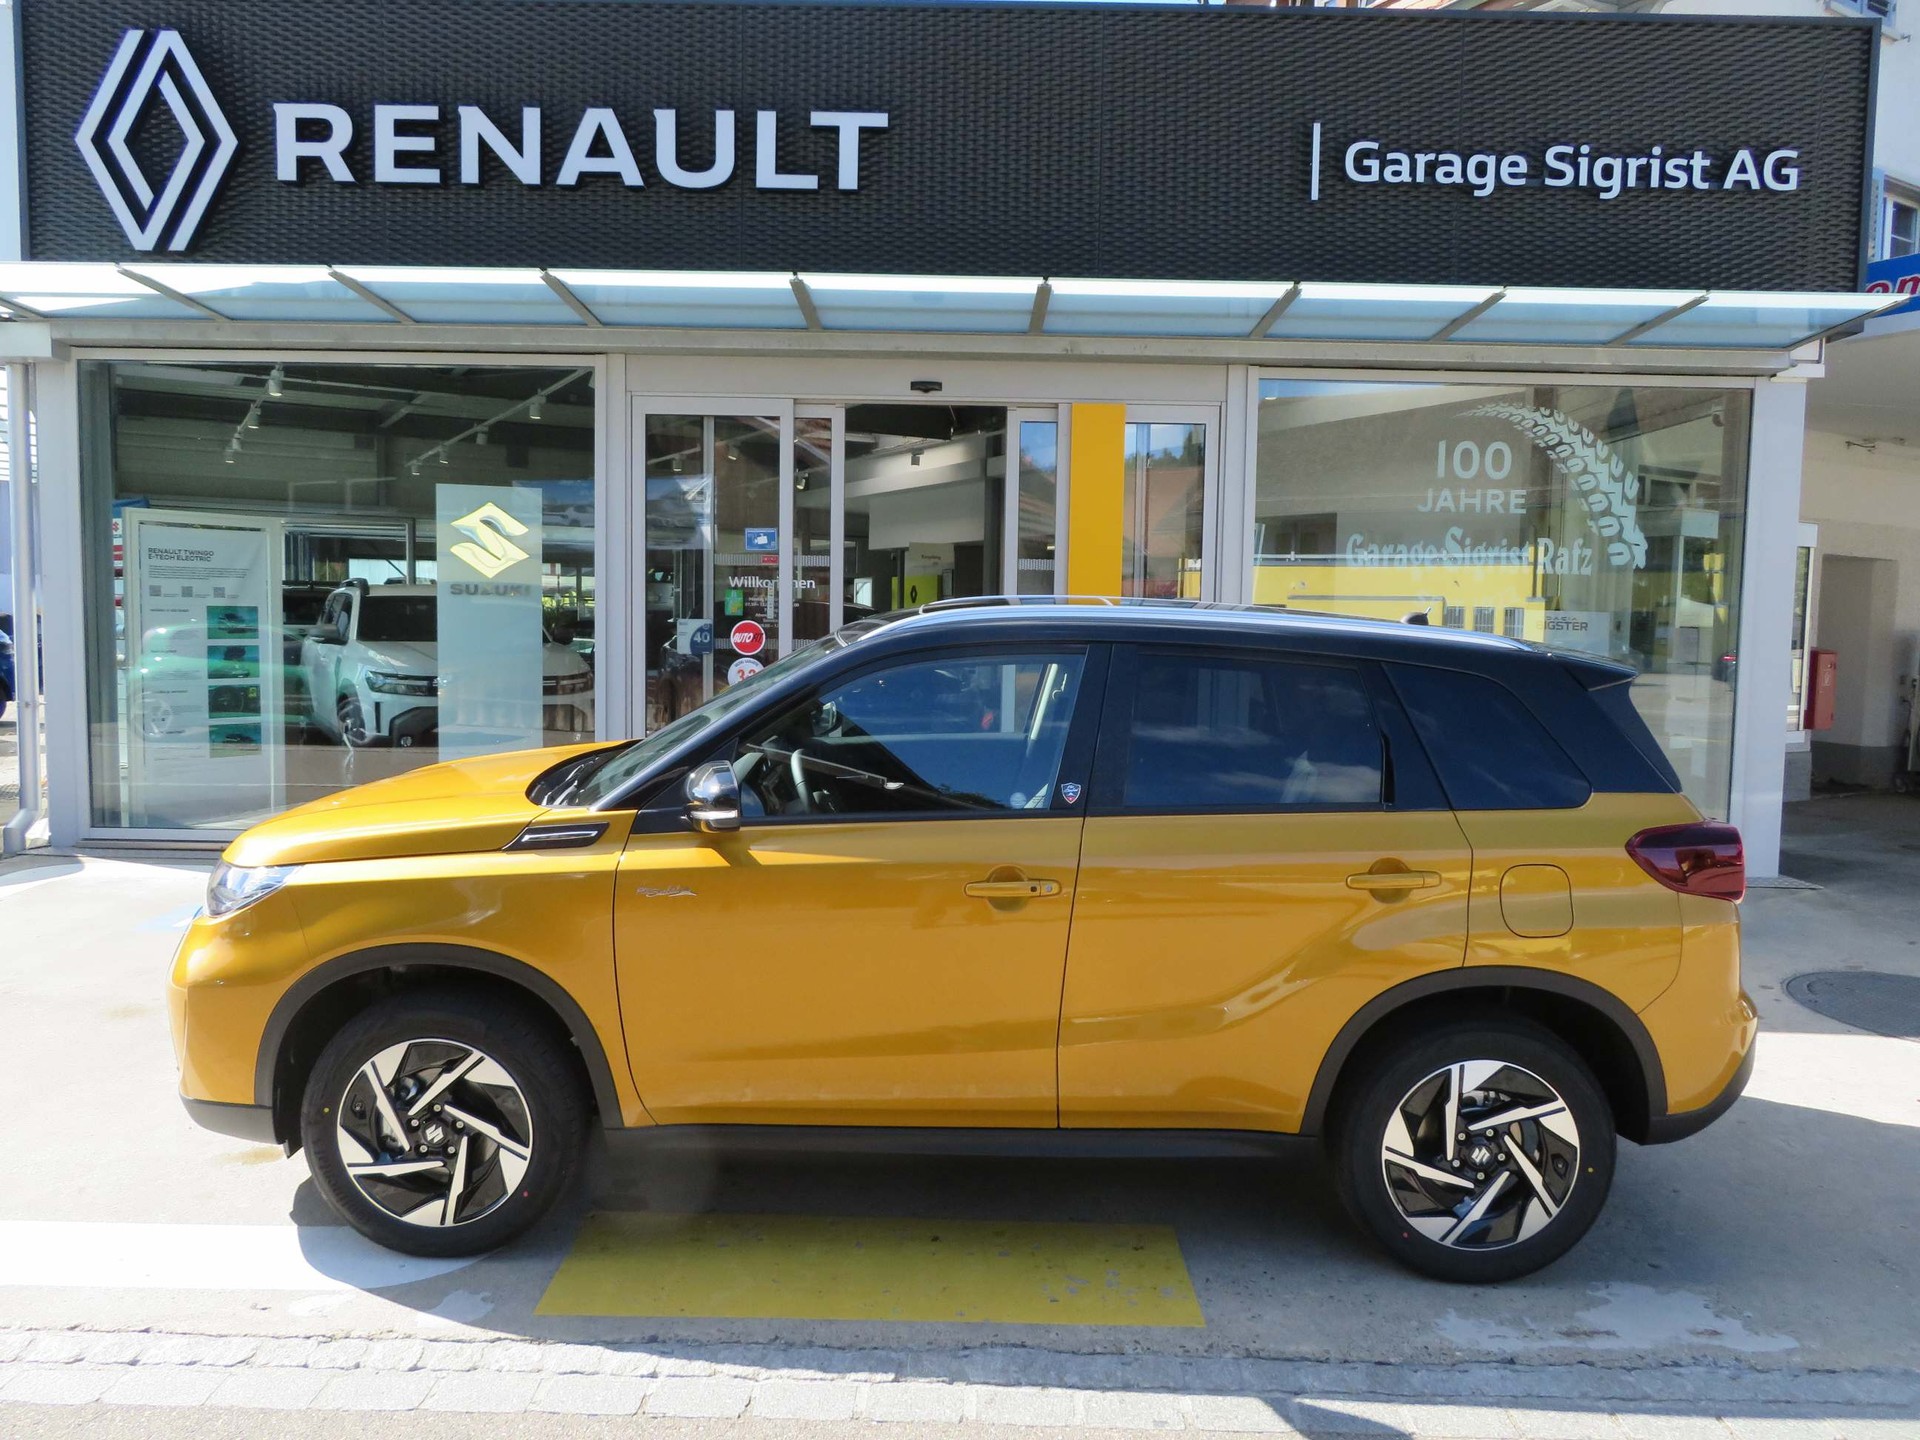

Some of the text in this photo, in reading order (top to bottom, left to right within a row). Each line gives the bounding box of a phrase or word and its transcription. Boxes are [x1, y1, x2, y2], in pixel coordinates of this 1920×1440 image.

[273, 102, 889, 191] RENAULT
[1344, 140, 1800, 200] Garage Sigrist AG
[1436, 439, 1513, 480] 100
[1416, 487, 1528, 514] JAHRE
[148, 547, 215, 557] RENAULT TWINGO
[176, 554, 212, 562] ELECTRIC
[1346, 525, 1594, 581] Garage Sigrist Rafz
[450, 583, 532, 597] SUZUKI
[692, 631, 711, 644] 40
